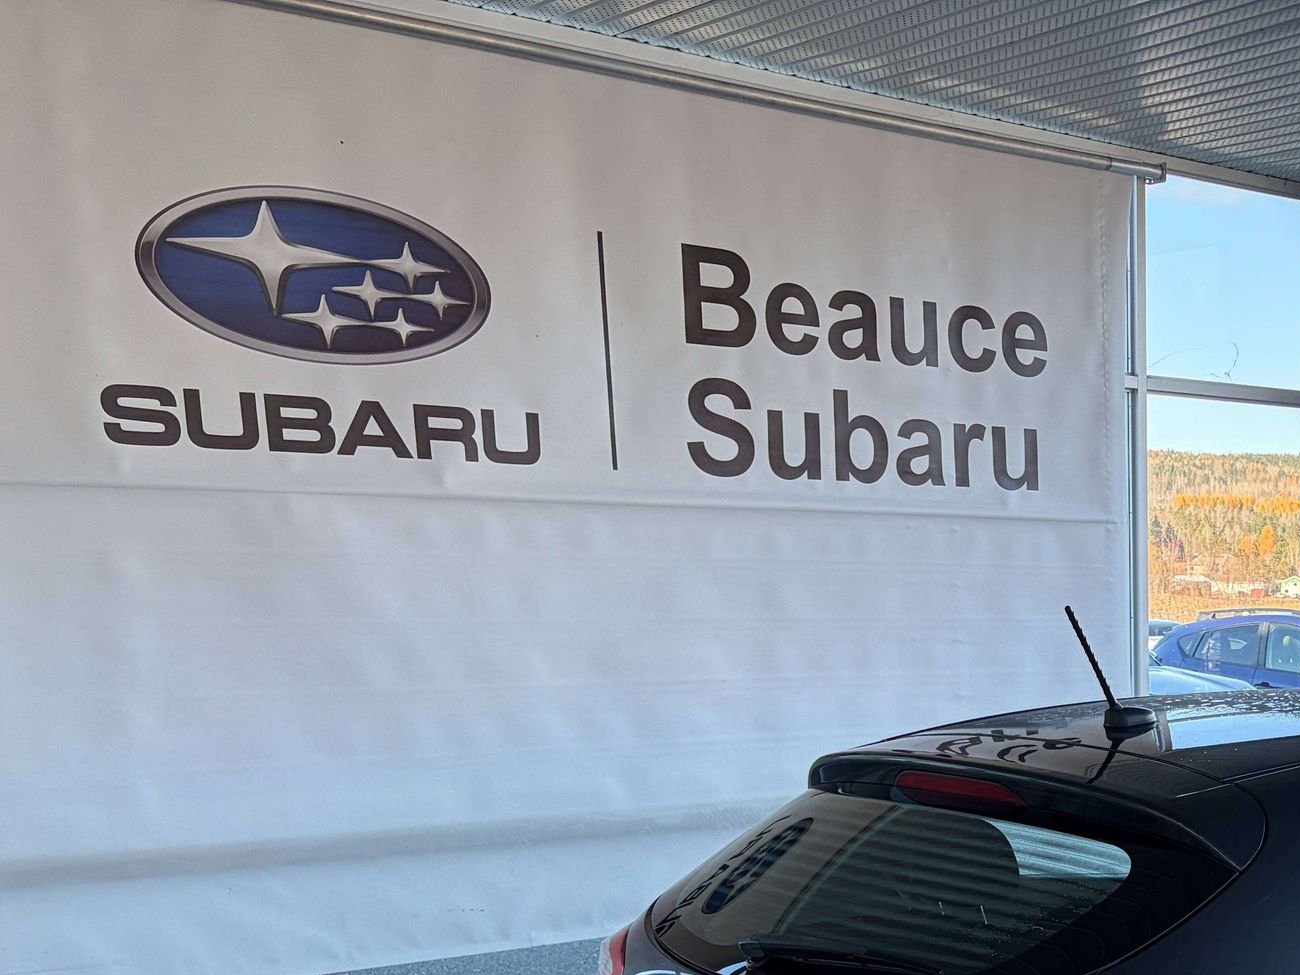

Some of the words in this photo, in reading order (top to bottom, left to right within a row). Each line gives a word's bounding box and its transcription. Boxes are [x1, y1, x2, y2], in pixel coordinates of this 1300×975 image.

[680, 243, 1049, 377] Beauce
[101, 383, 542, 466] SUBARU
[686, 377, 1040, 491] Subaru
